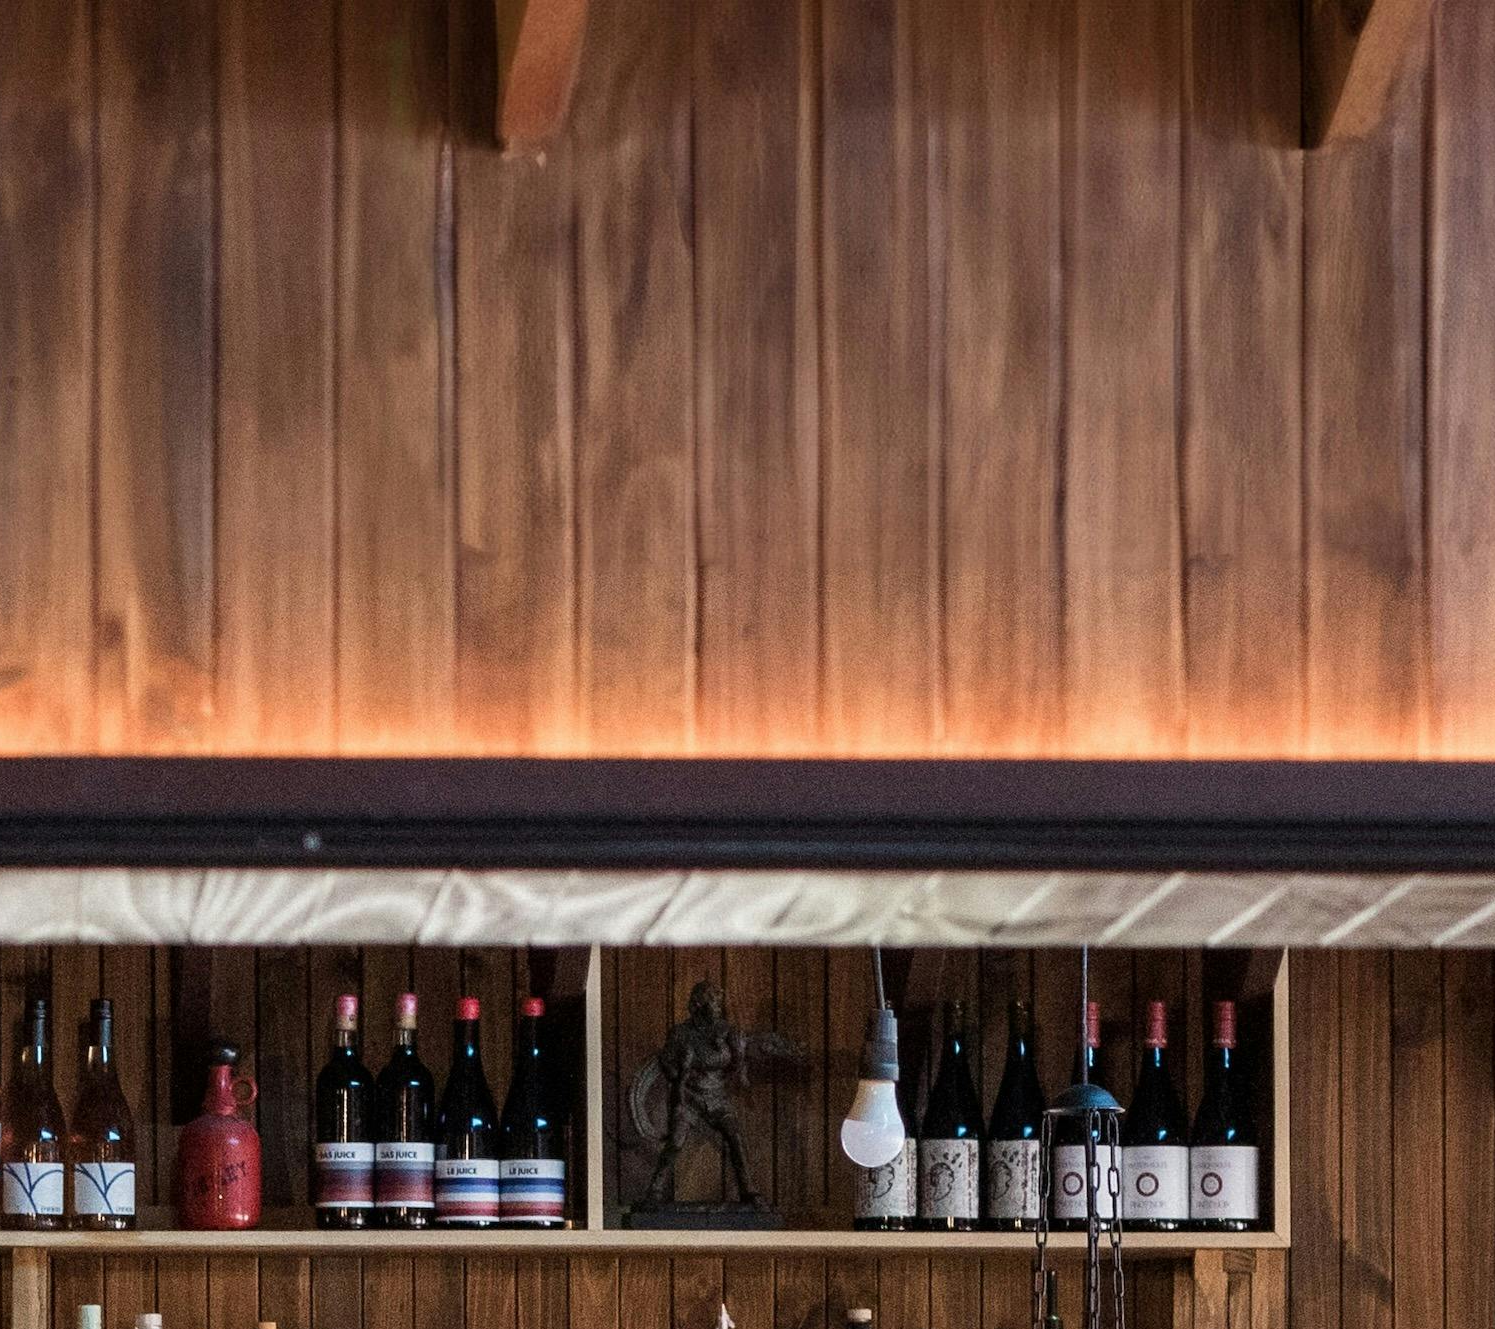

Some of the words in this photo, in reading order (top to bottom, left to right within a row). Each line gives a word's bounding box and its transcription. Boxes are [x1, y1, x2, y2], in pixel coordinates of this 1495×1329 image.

[333, 1150, 356, 1160] JUICE
[395, 1150, 417, 1160] JUICE
[457, 1166, 478, 1176] JUICE
[519, 1166, 539, 1176] JUICE
